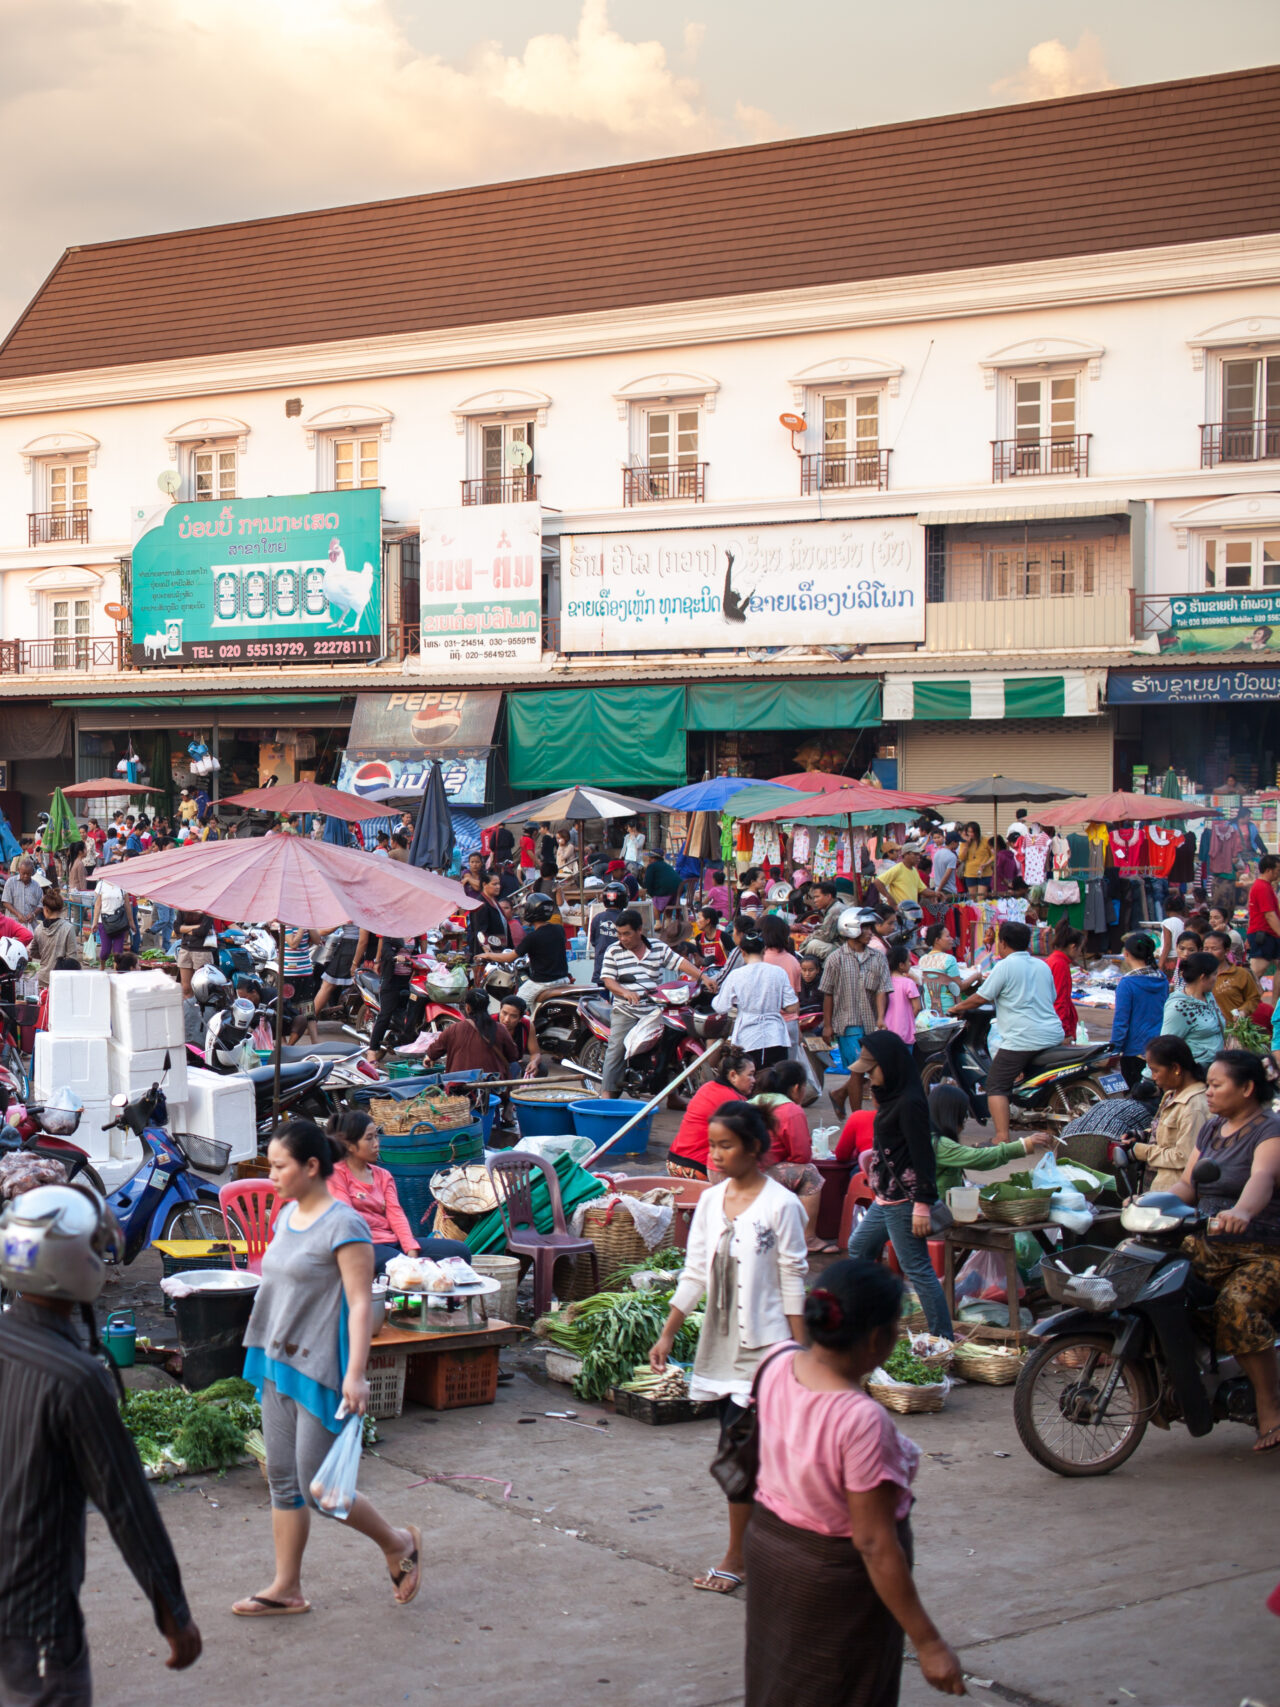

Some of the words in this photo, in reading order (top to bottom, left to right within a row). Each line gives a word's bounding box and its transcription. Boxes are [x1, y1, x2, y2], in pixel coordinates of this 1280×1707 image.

[192, 646, 214, 659] TEL:
[219, 644, 241, 658] 020
[246, 641, 308, 658] 55513729,
[313, 640, 372, 656] 22278111
[386, 692, 468, 712] PEPSI
